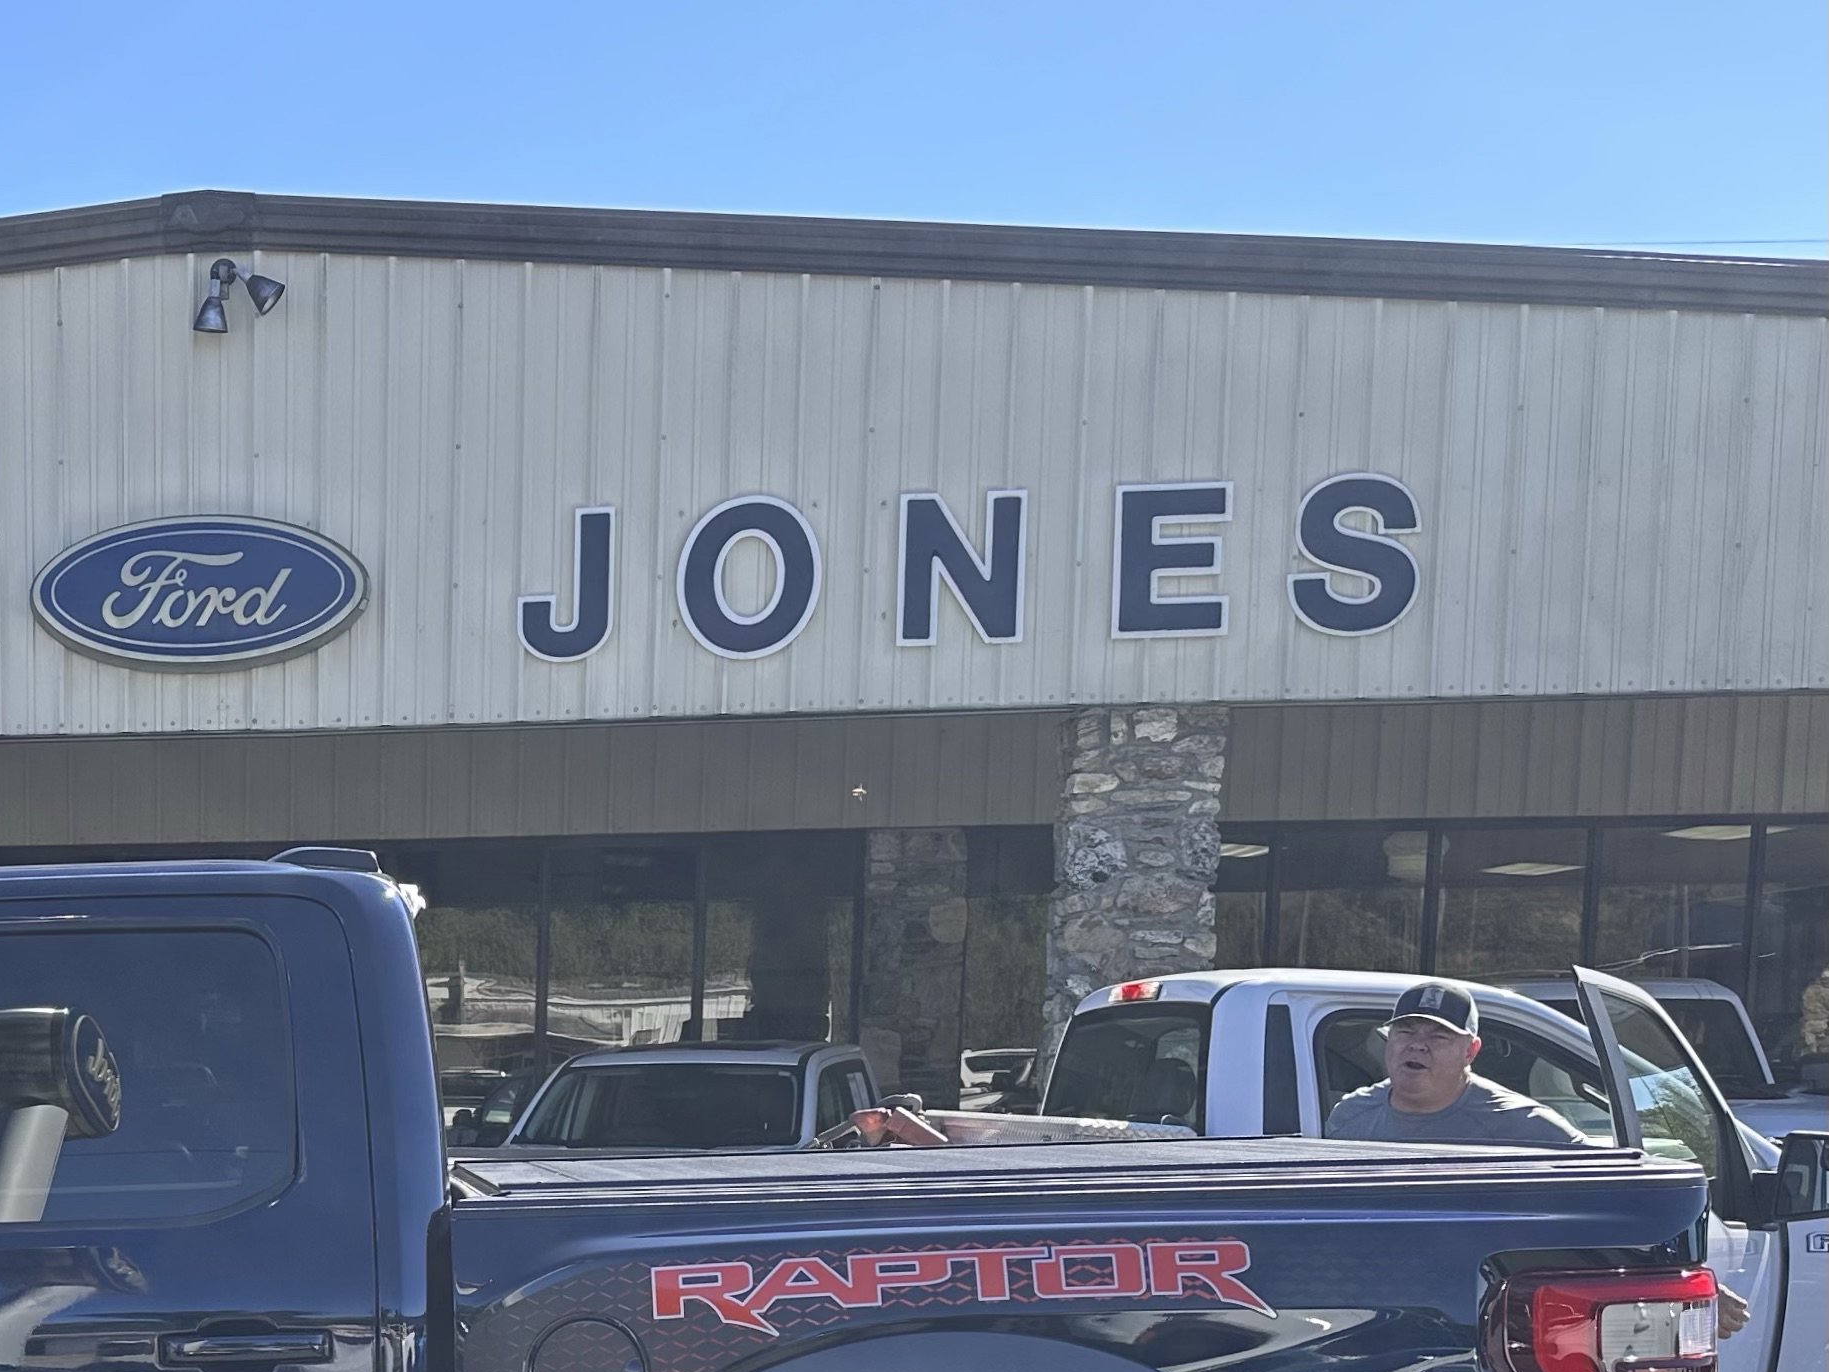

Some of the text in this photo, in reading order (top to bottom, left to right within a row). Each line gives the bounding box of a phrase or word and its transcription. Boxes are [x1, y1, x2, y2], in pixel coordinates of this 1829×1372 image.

[99, 549, 290, 630] Ford
[516, 471, 1422, 664] JONES
[650, 1240, 1277, 1338] RAPTOR
